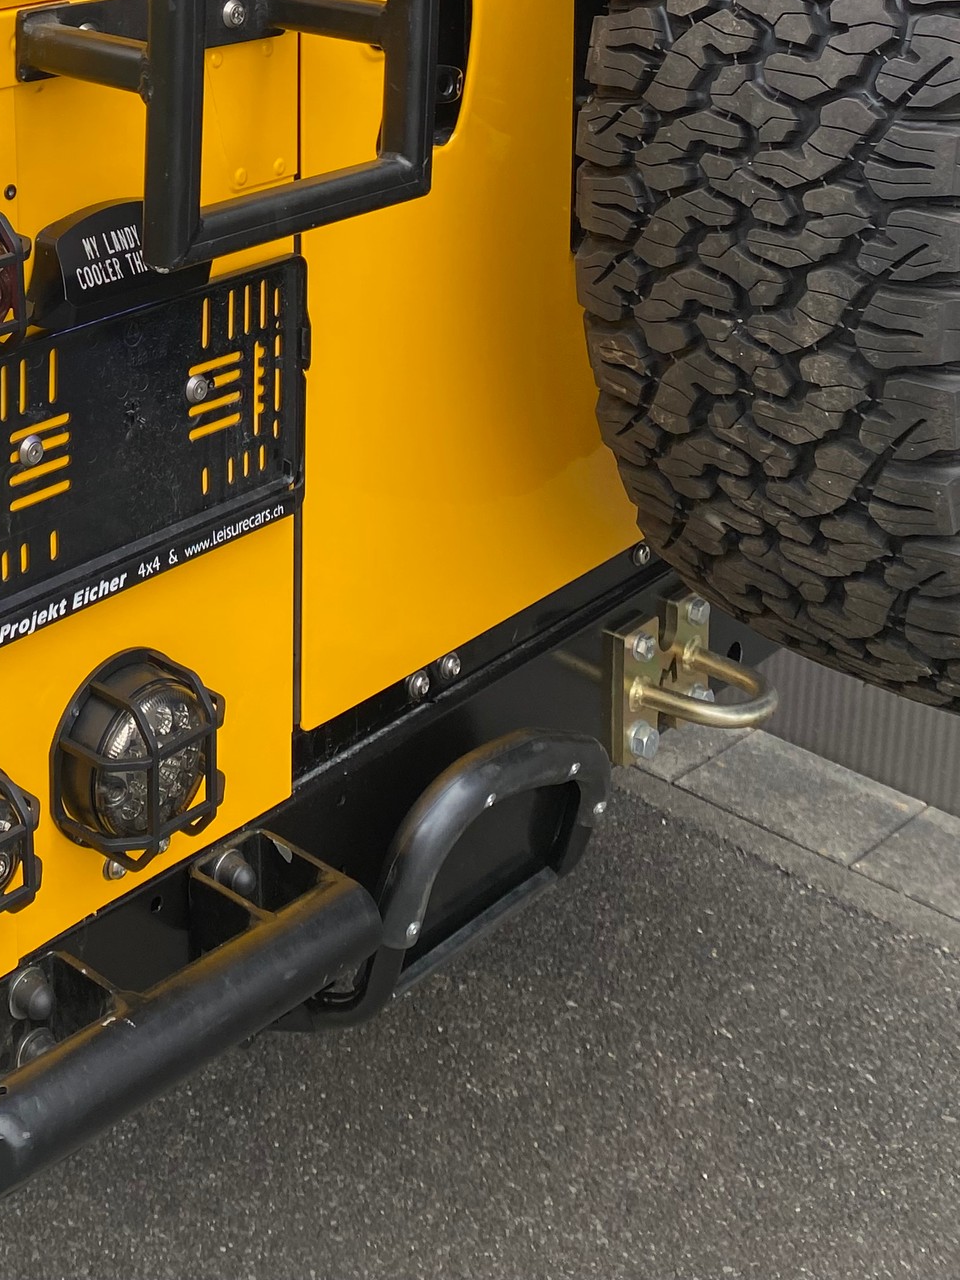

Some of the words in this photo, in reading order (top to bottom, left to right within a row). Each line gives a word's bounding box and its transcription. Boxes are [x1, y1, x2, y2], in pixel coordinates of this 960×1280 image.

[82, 236, 100, 260] MY
[103, 225, 140, 254] LANDY
[76, 258, 124, 289] COOLER
[72, 570, 129, 609] Eicher
[137, 555, 161, 579] 4x4
[168, 548, 179, 565] &
[184, 503, 285, 558] www.Leisurecars.ch
